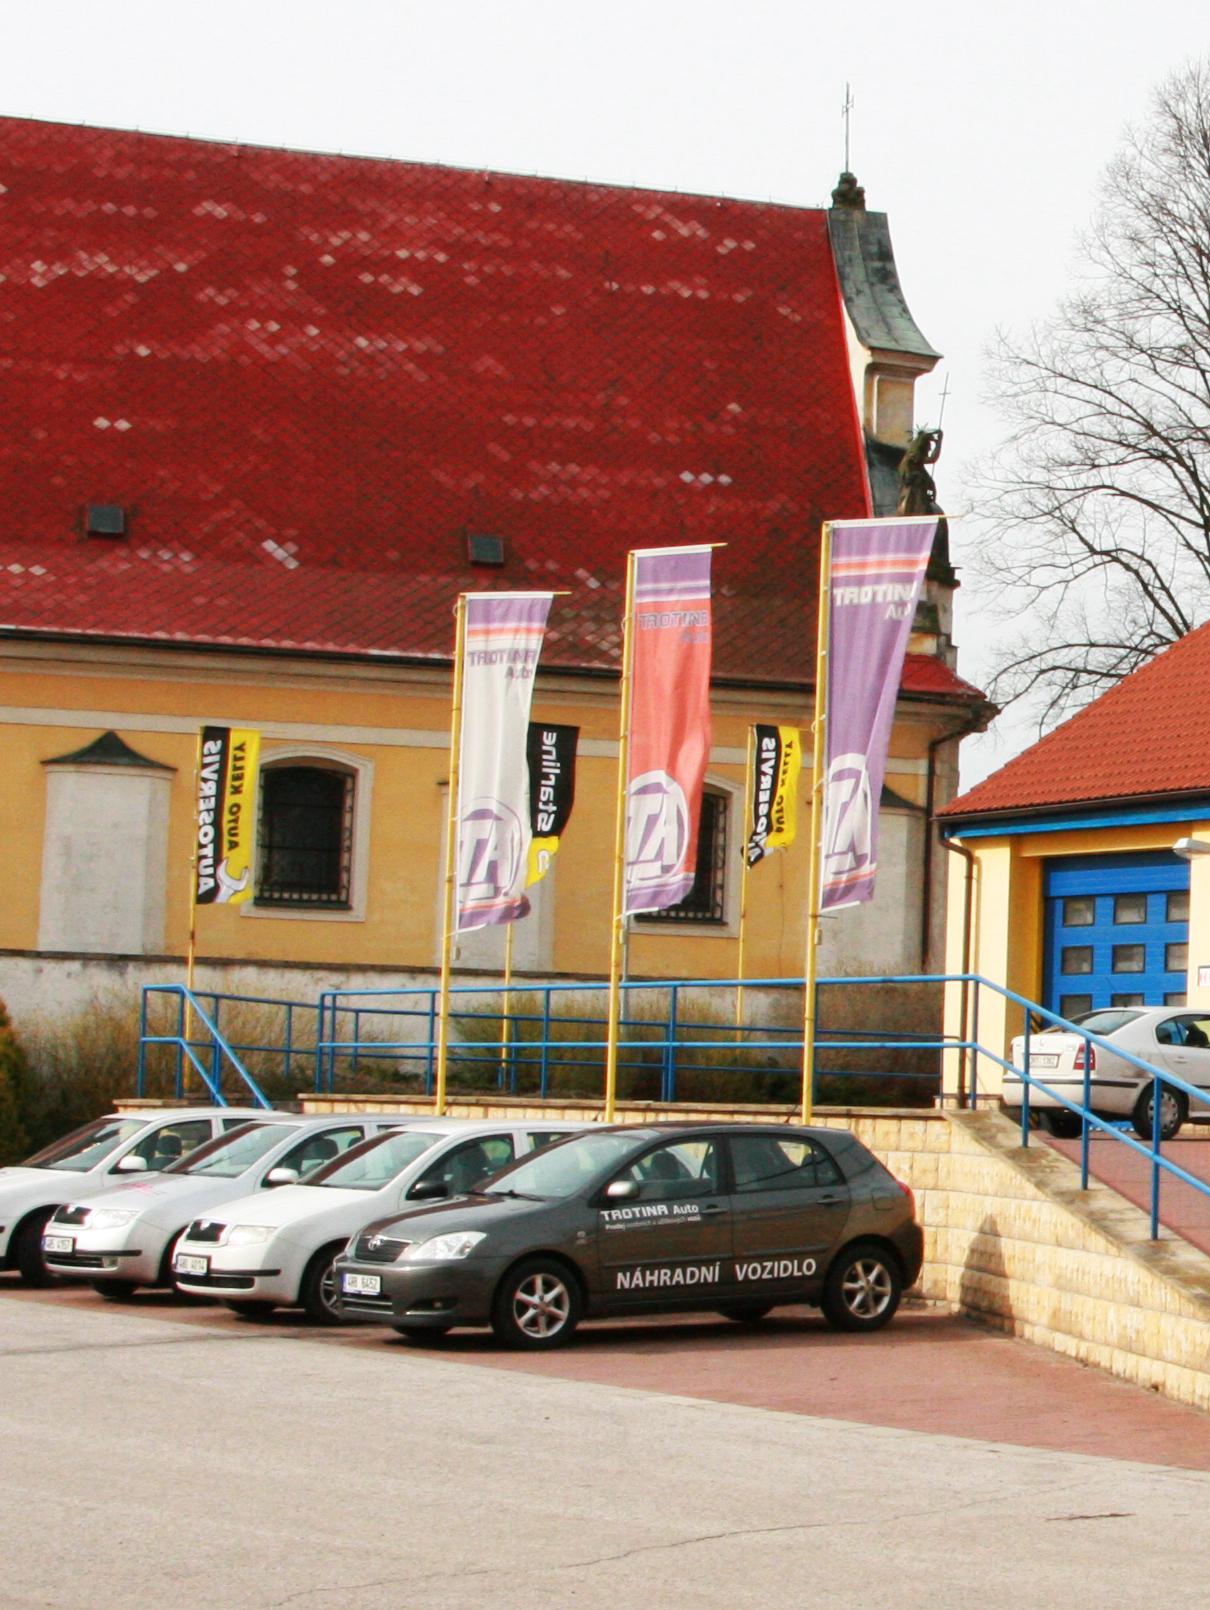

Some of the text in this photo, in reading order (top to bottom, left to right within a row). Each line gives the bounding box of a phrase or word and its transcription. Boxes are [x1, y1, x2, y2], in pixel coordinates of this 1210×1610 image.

[600, 1204, 669, 1222] TROTINA
[673, 1204, 699, 1215] Auto
[616, 1258, 817, 1289] NÁHRADNÍ VOZIDLO
